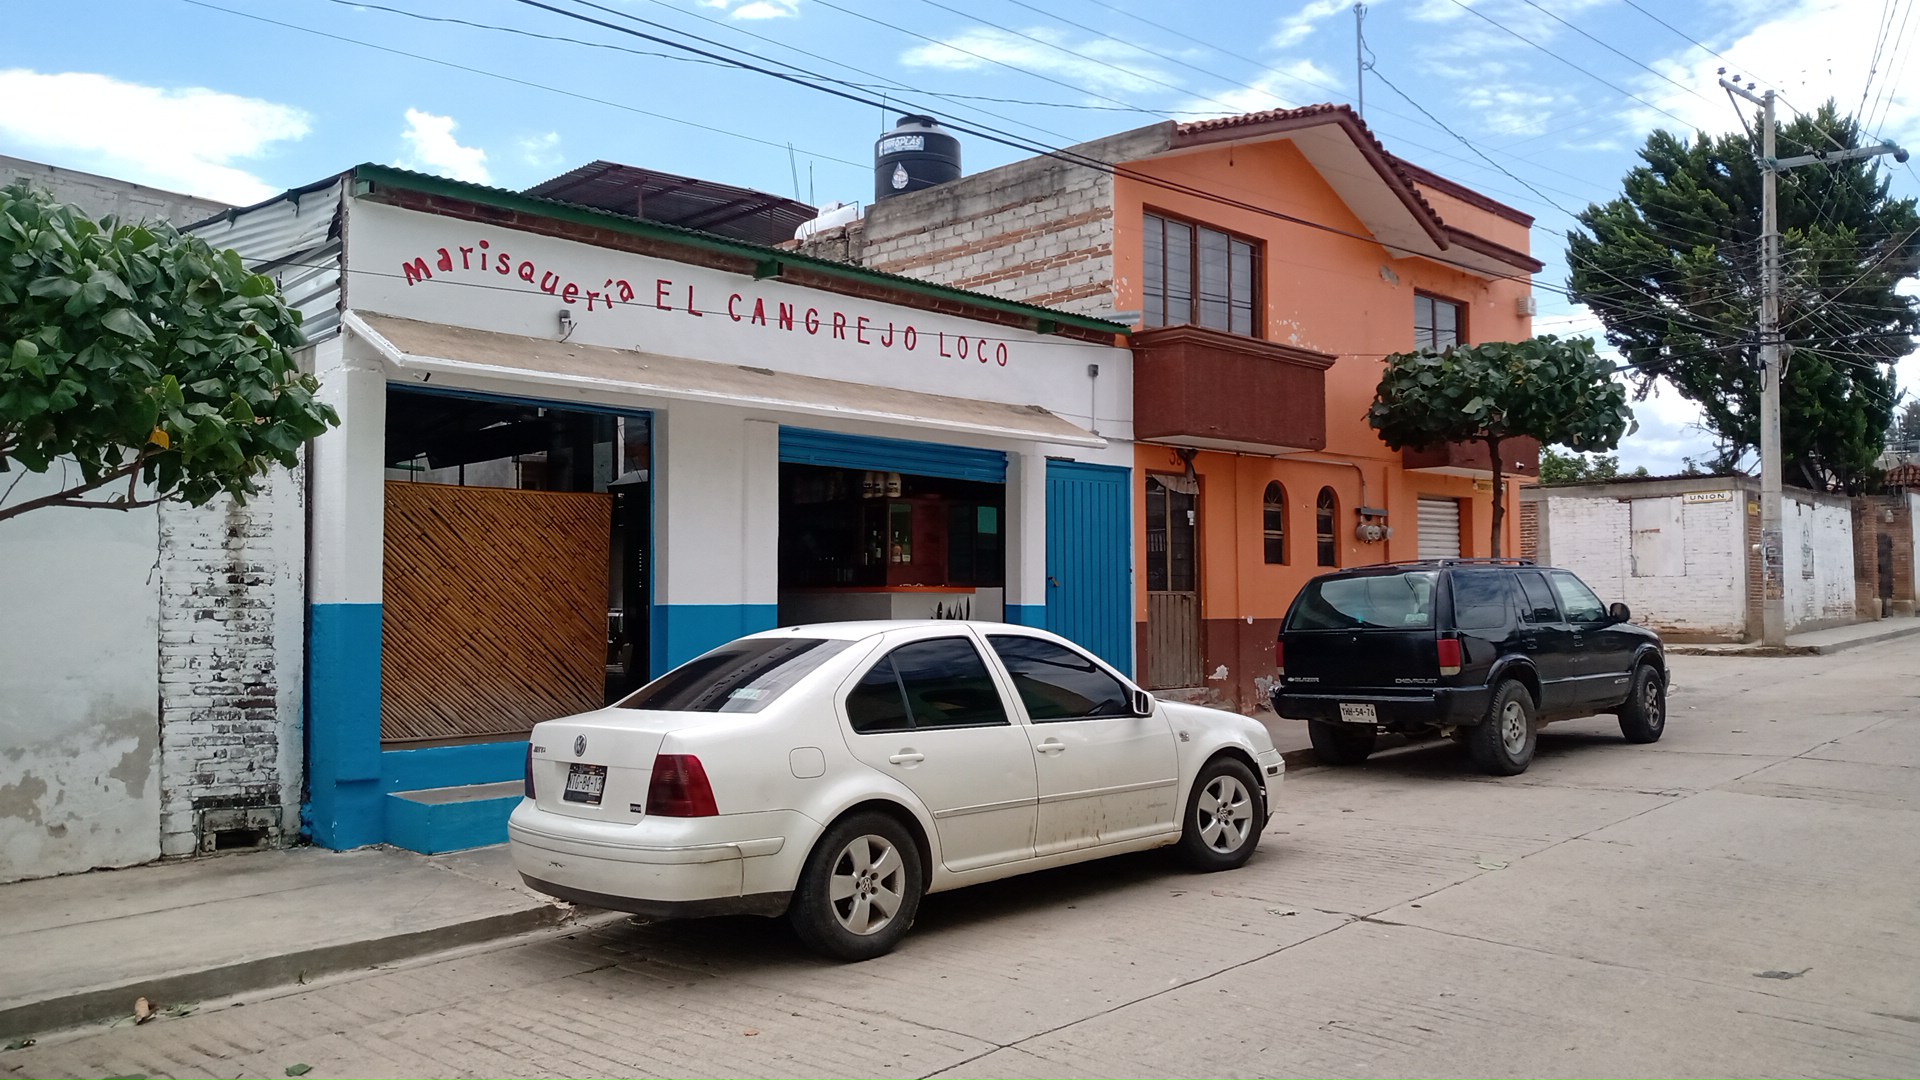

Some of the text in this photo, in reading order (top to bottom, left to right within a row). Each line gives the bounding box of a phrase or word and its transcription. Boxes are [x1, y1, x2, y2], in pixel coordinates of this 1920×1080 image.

[656, 279, 703, 317] EL
[728, 293, 917, 351] CANGREJO
[939, 331, 1008, 367] LOCO
[1689, 493, 1725, 501] UNION
